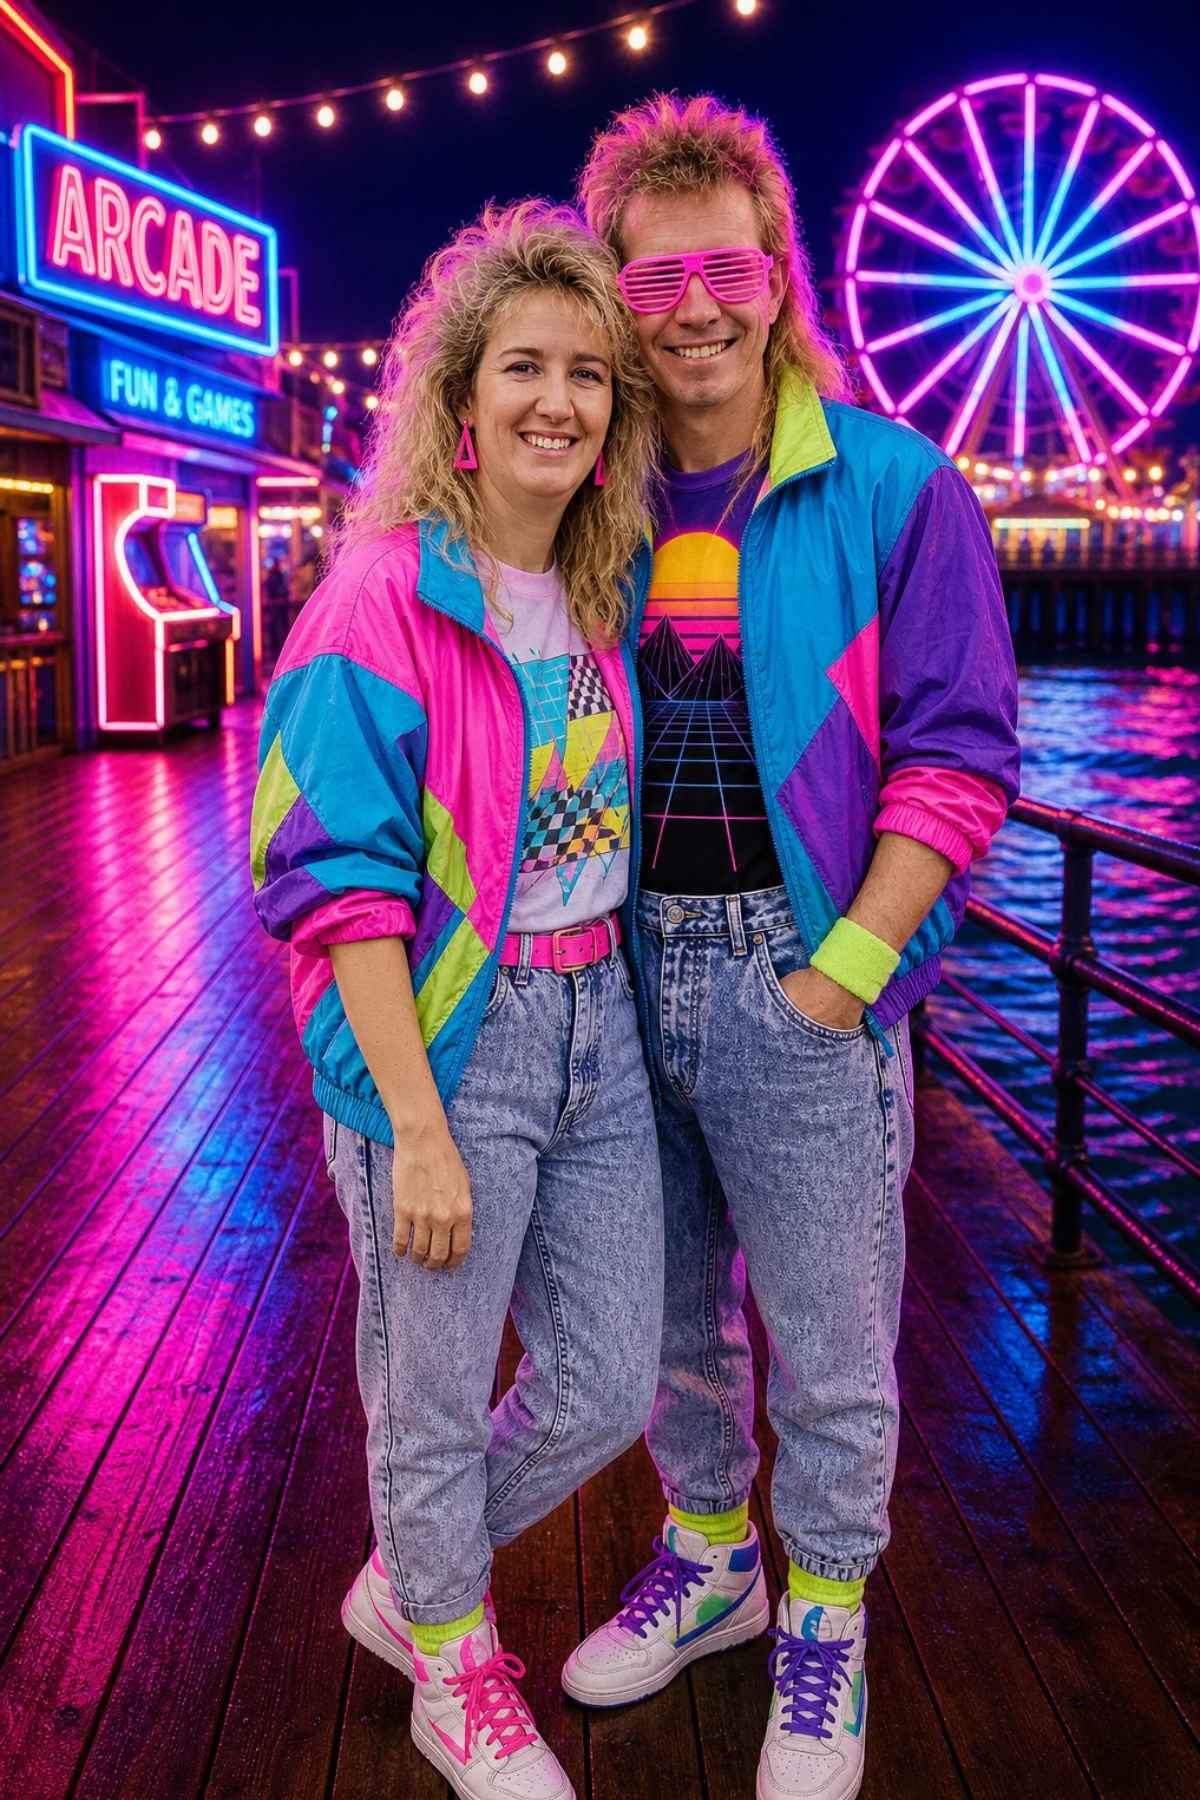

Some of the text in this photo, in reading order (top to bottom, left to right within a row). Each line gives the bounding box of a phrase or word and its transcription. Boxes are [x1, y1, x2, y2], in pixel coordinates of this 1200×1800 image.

[51, 164, 262, 328] ARCADE
[110, 360, 255, 438] FUN & GAMES
